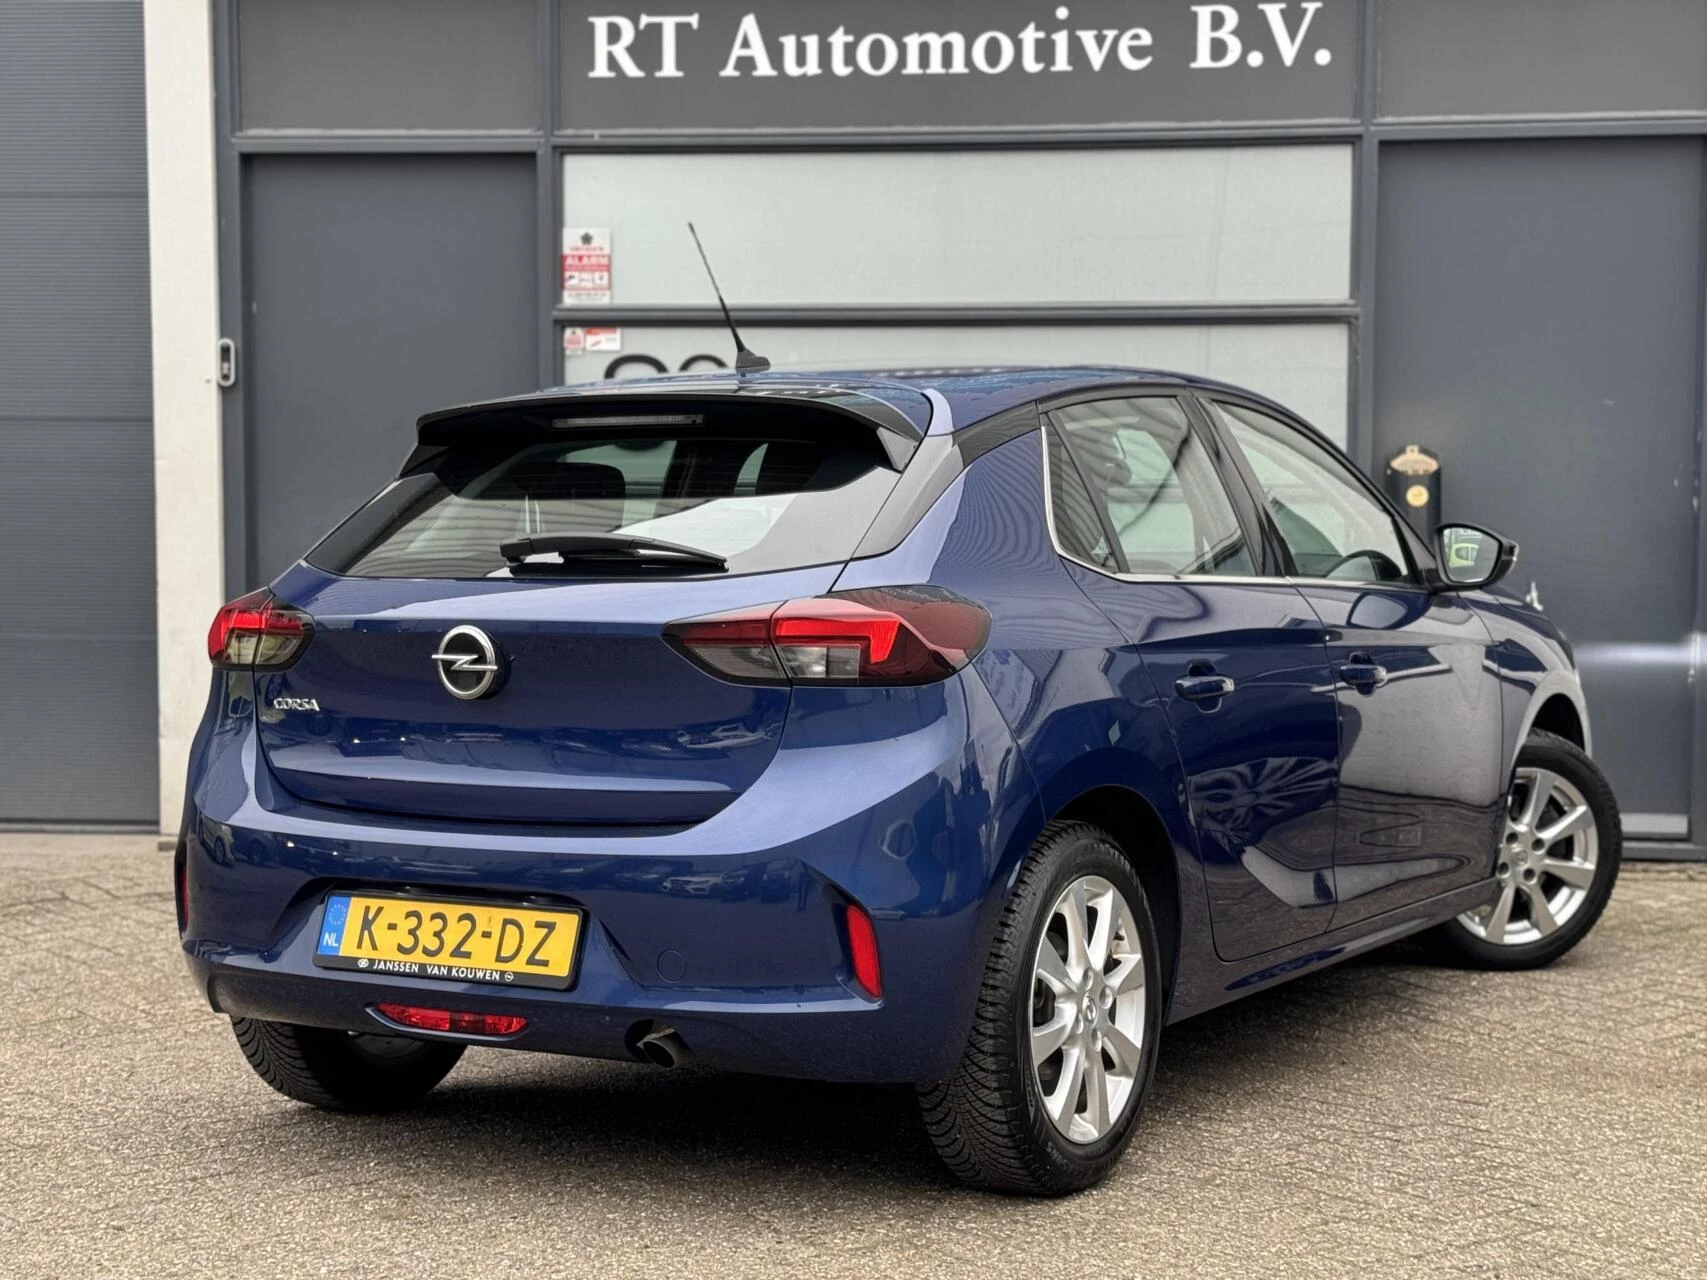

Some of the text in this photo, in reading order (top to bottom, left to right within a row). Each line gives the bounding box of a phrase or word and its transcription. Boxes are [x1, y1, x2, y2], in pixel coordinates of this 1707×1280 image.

[588, 1, 1332, 79] RT Automotive B.V.
[273, 697, 320, 712] CORSA
[323, 932, 339, 948] NL
[356, 904, 557, 967] K-332-DZ
[373, 959, 419, 974] JANSSEN
[426, 964, 448, 976] VAN
[451, 967, 501, 981] KOUWEN
